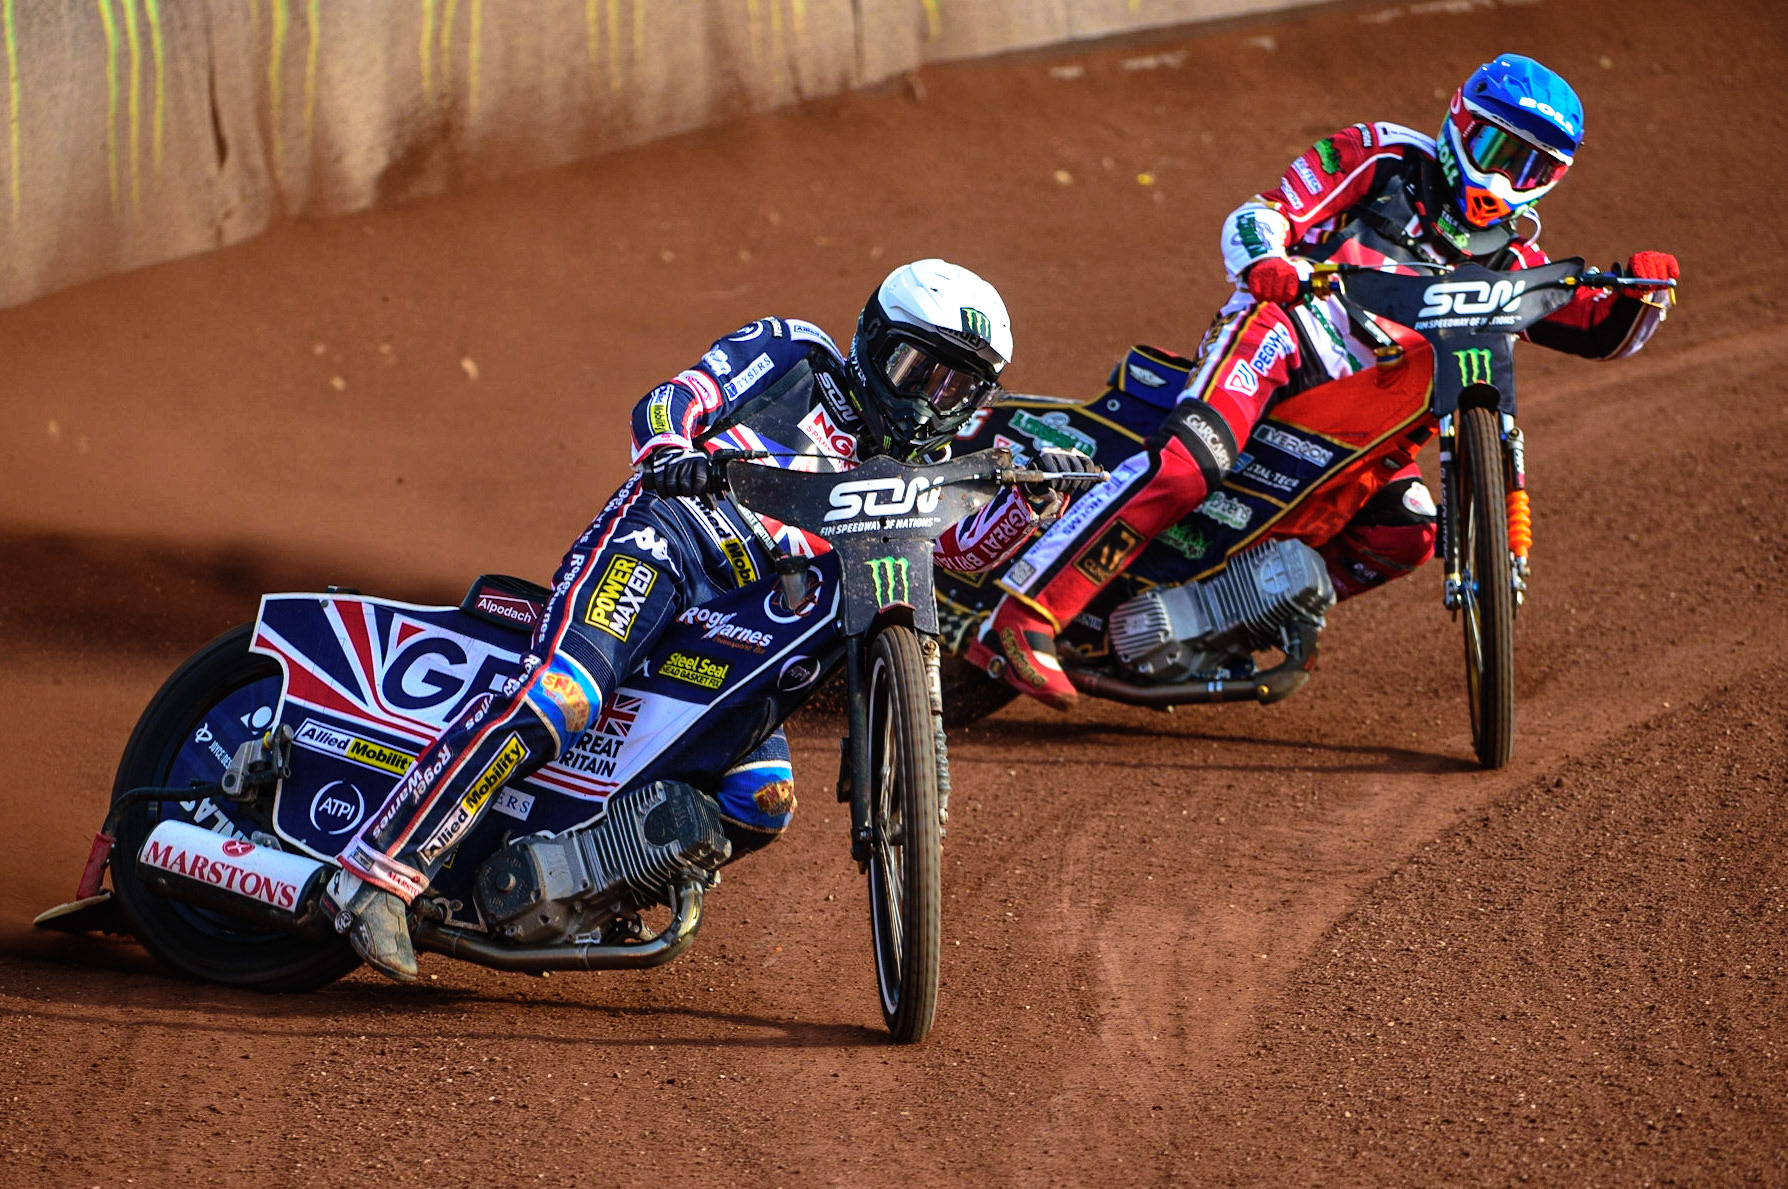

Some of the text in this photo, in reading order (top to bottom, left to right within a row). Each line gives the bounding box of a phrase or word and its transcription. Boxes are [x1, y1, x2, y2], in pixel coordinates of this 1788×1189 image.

[735, 355, 772, 390] TYSERS
[820, 525, 836, 537] FIM
[983, 508, 1027, 561] GREAT
[590, 557, 637, 627] POWER
[608, 565, 653, 636] MAXED
[477, 596, 533, 625] Alpodach
[666, 651, 730, 680] Steel Seal
[680, 669, 711, 687] GASKET
[301, 725, 351, 754] Allied
[575, 732, 624, 759] REAT
[414, 743, 452, 804] Roger
[559, 751, 617, 778] RITAIN
[318, 793, 356, 822] ATPI
[371, 768, 423, 840] Warnes
[425, 743, 522, 860] Allied Mobility
[145, 840, 298, 912] MARSTON'S
